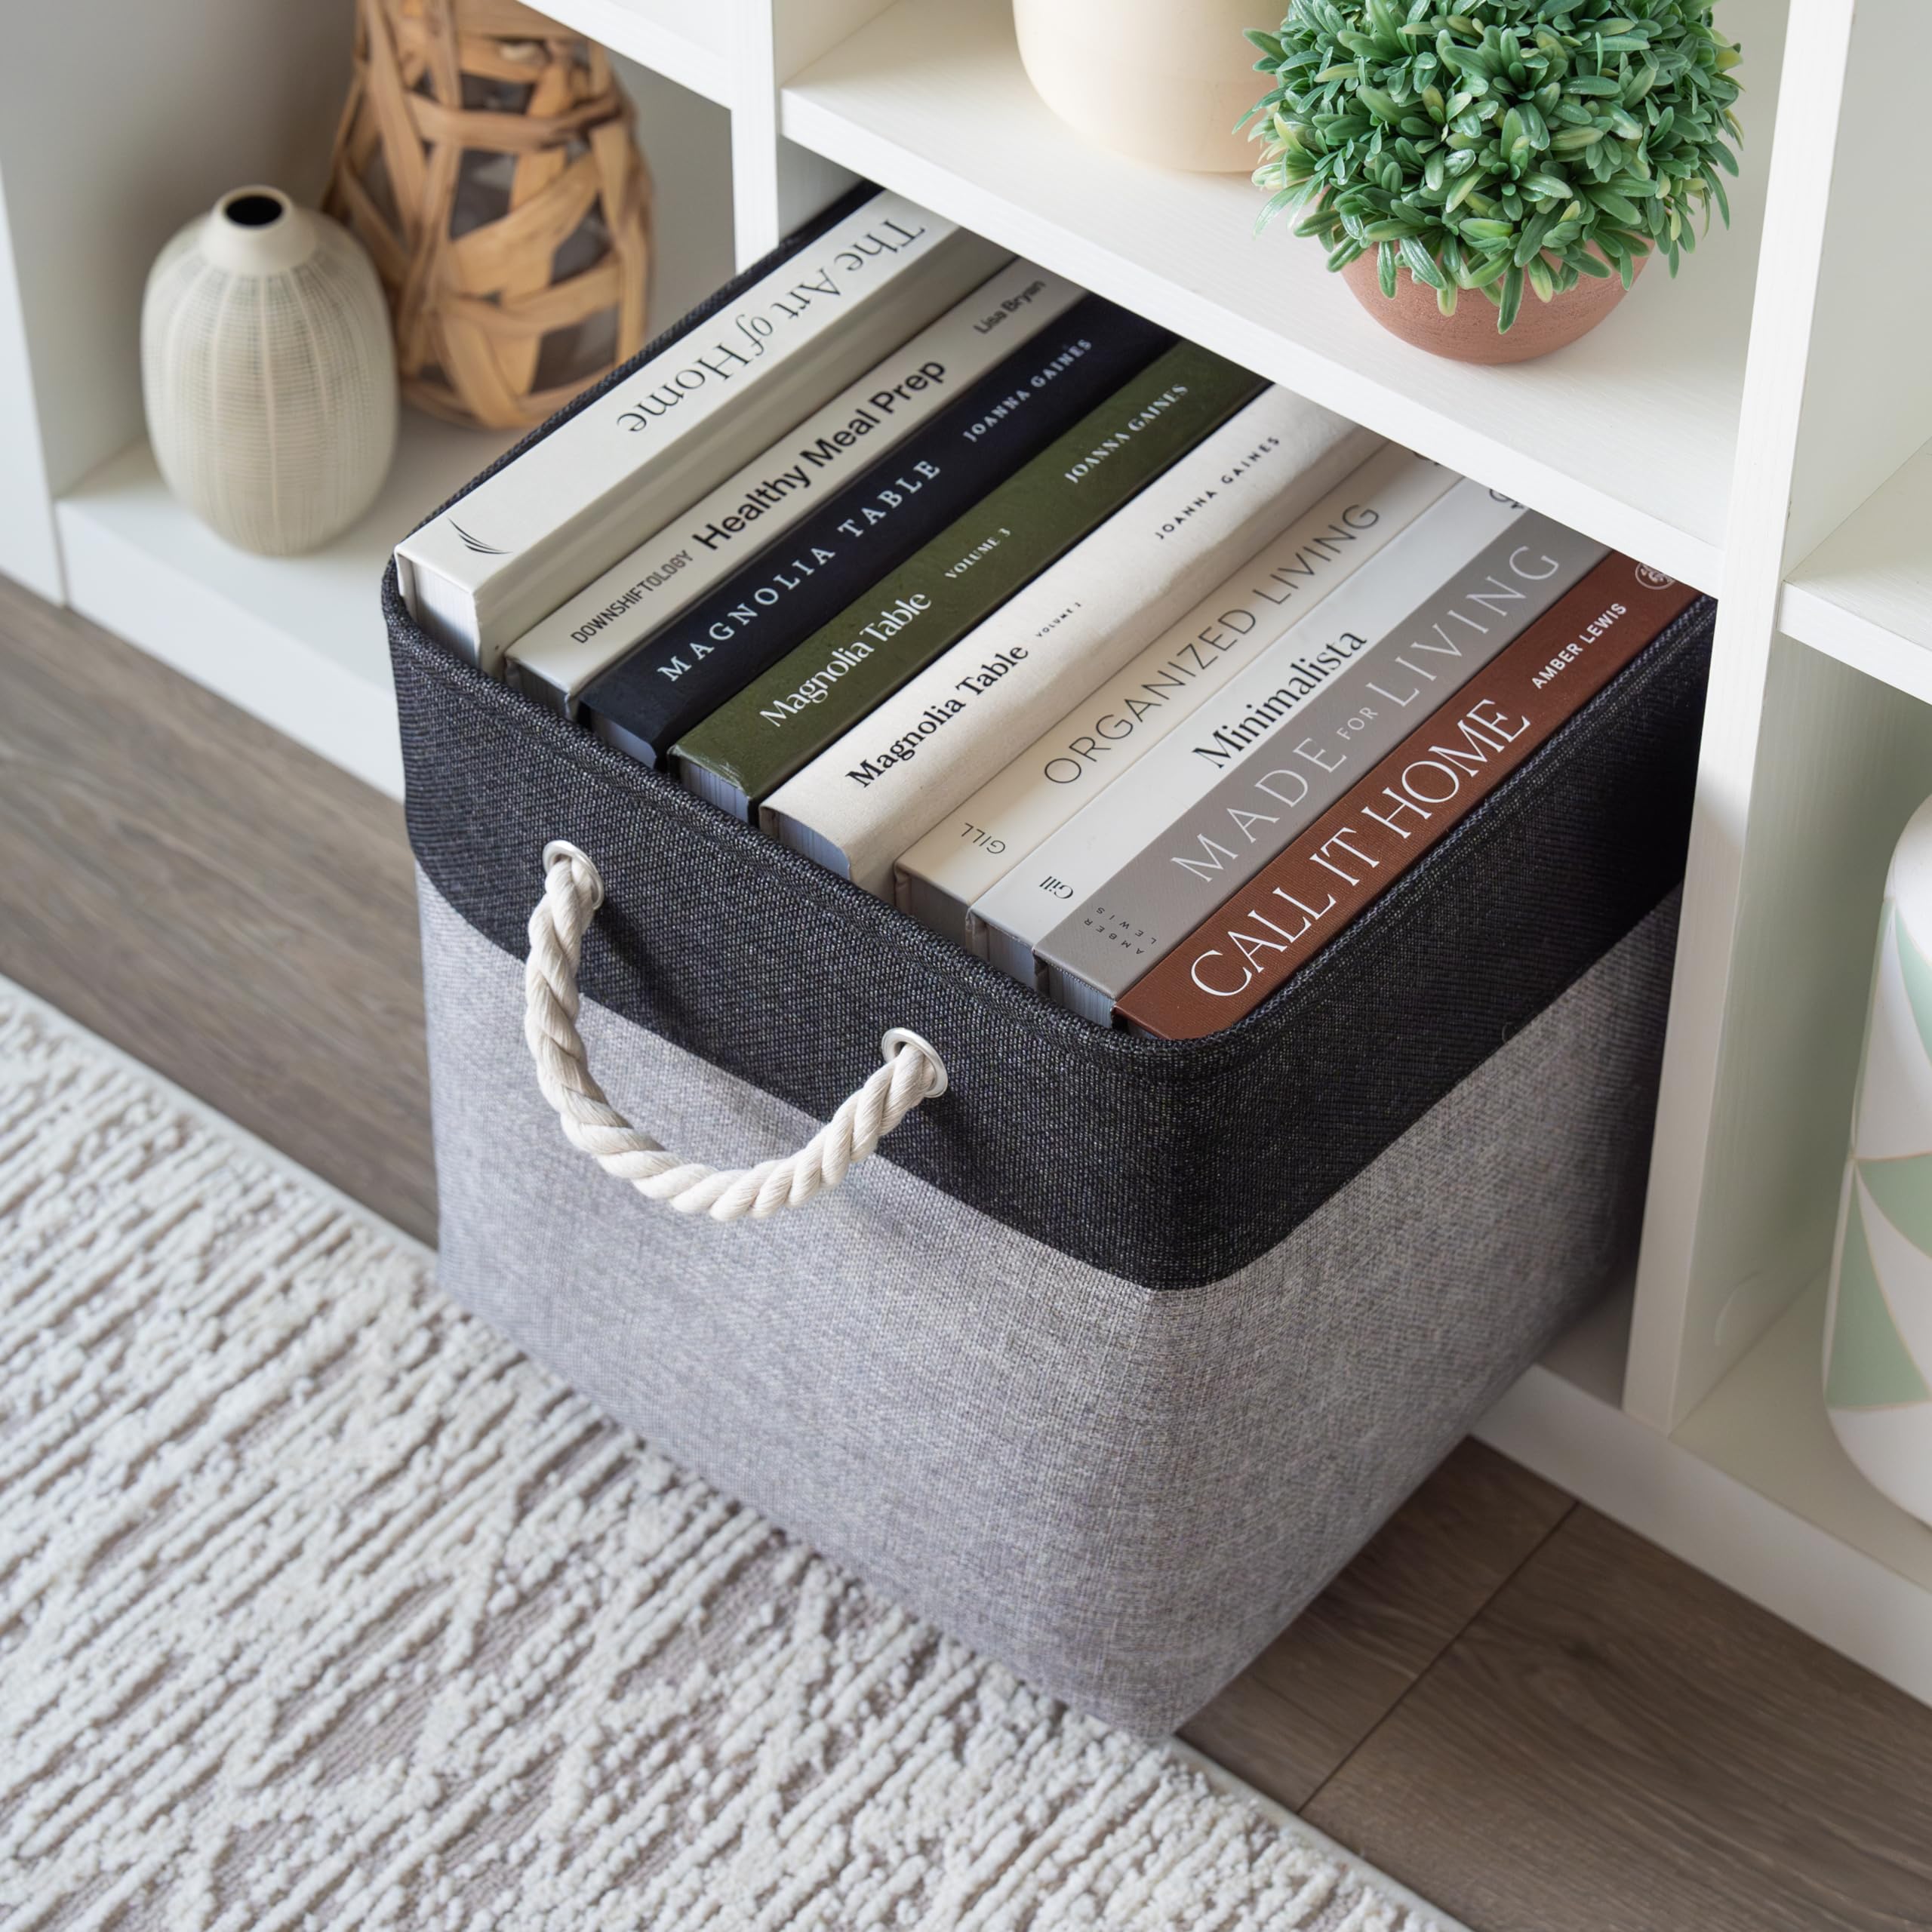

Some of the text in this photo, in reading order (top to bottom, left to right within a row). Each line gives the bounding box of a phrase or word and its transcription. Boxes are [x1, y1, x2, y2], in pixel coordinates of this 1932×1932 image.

[616, 218, 926, 432] The Art of Home
[973, 280, 1046, 334] Lisa Bryan
[962, 339, 1092, 443] JOANNA GAINES
[1063, 383, 1189, 484] JOANNA GAINES
[692, 361, 946, 551] Healthy Meal Prep
[1155, 435, 1280, 540] JOANNA GAINES
[570, 549, 694, 645] DOWNSHIFTOLOGY
[657, 459, 942, 682] MAGNOLIA TABLE
[943, 528, 1011, 581] VOLUME 3
[759, 591, 932, 728] Magnolia Table
[1035, 608, 1073, 637] VOLUME
[1043, 503, 1380, 786] ORGANIZED LIVING
[1531, 601, 1627, 690] AMBER LEWIS
[844, 641, 1028, 789] Magnolia Table
[1170, 545, 1560, 883] MADE FOR LIVING
[1191, 629, 1367, 769] Minimalista
[962, 821, 1006, 855] GILL
[1038, 875, 1074, 900] Gill
[1190, 698, 1531, 997] CALL IT HOME
[1083, 918, 1145, 955] AMBER
[1096, 906, 1157, 945] LEWIS
